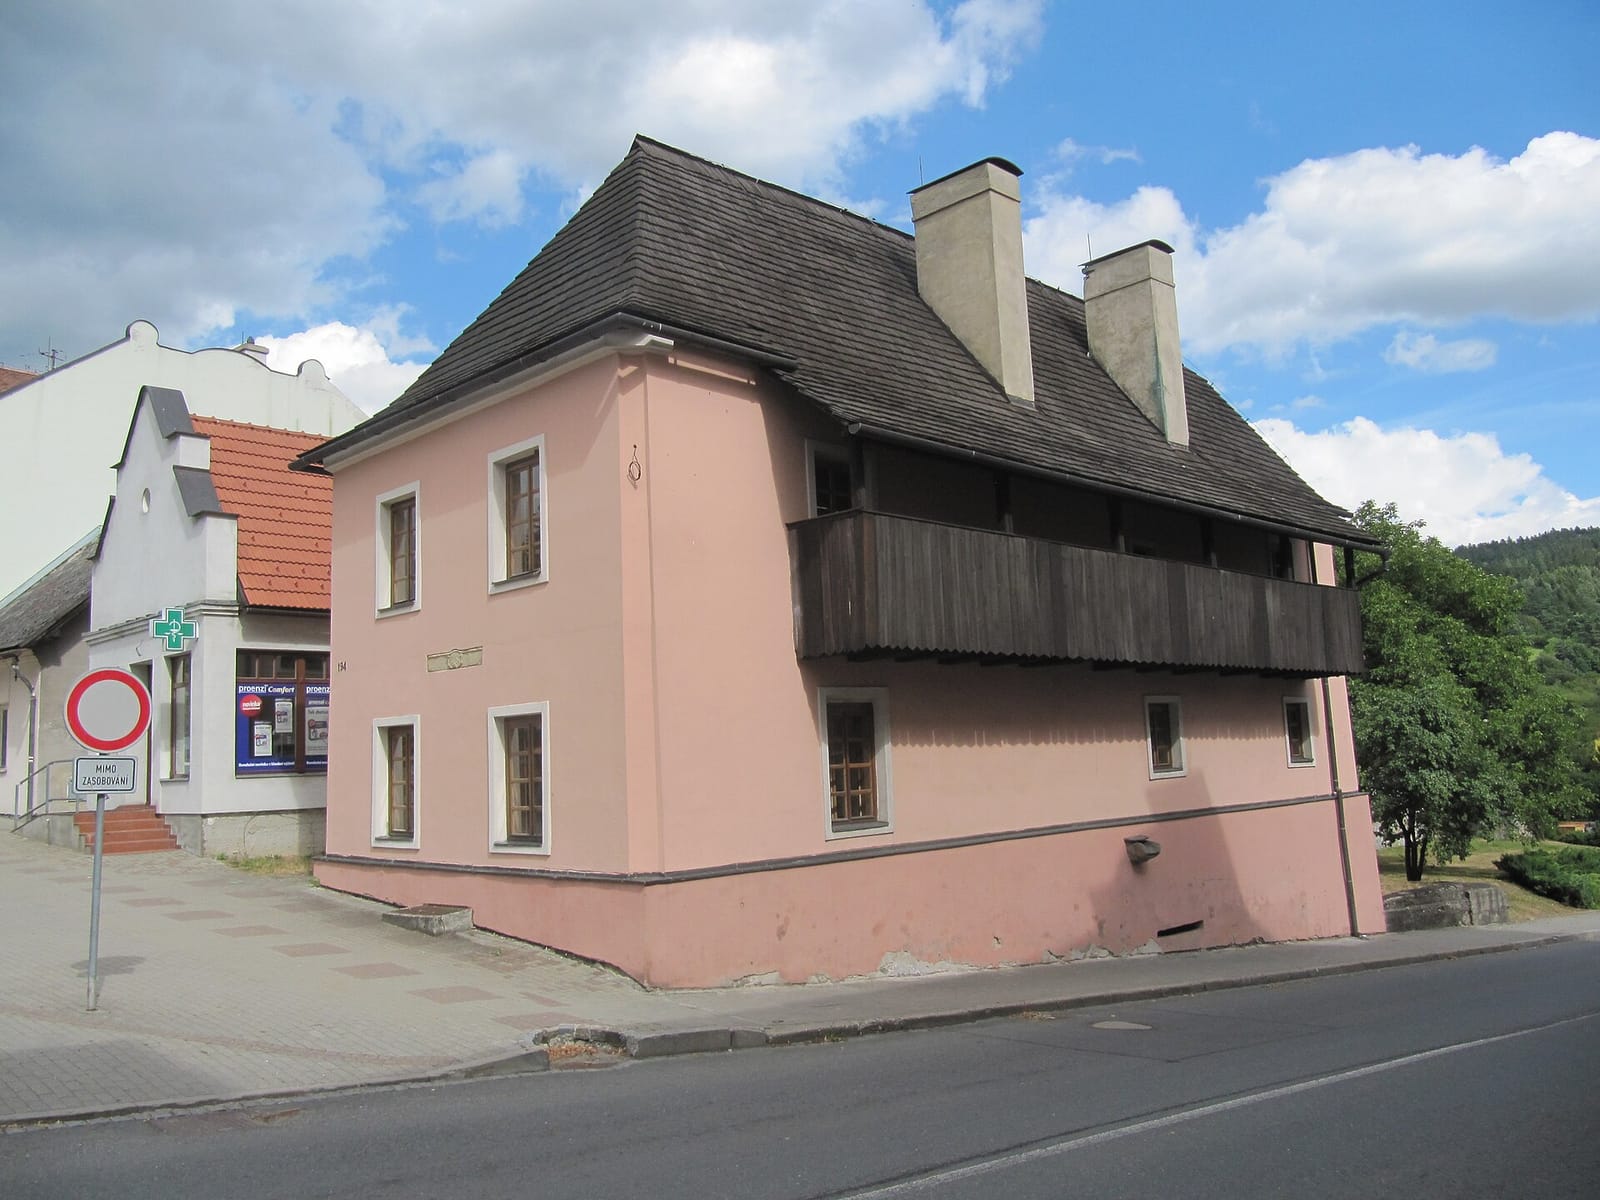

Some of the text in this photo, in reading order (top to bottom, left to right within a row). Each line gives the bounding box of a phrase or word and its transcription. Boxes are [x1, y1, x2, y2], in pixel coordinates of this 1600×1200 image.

[268, 686, 295, 694] Comfort
[306, 686, 331, 694] proenz
[95, 764, 117, 774] MIMO
